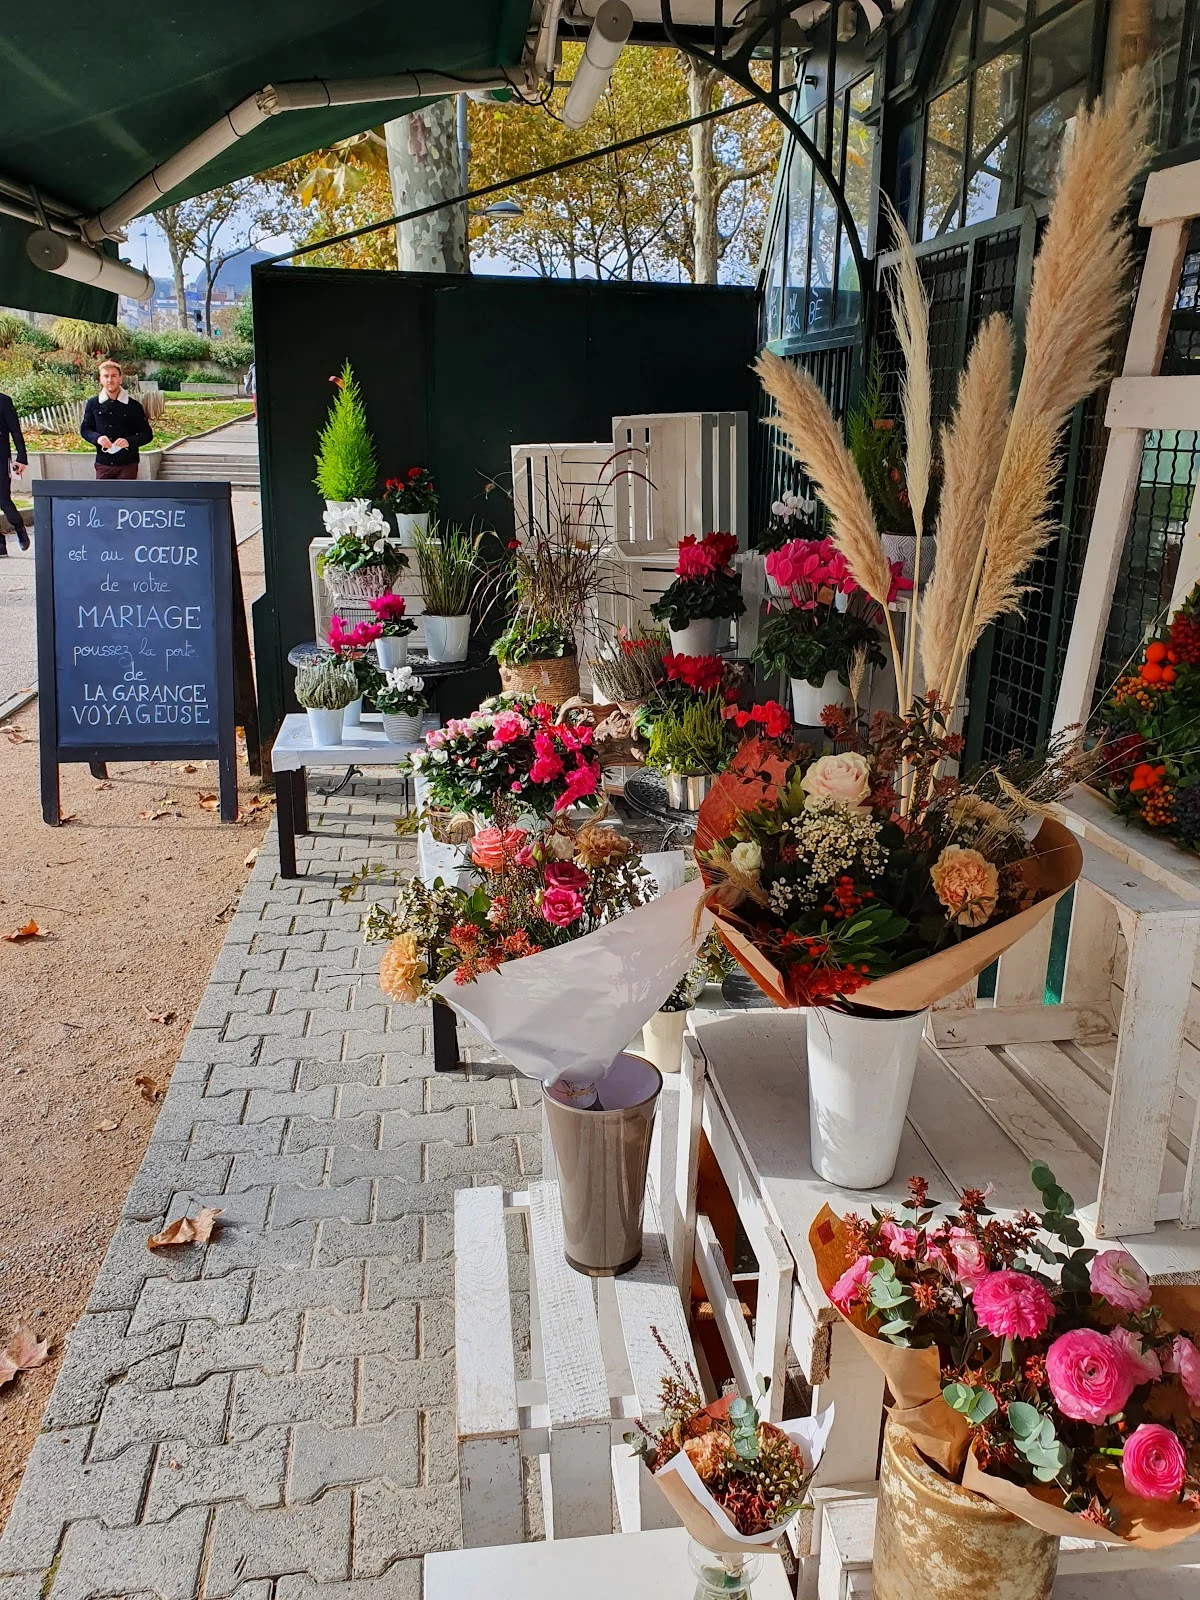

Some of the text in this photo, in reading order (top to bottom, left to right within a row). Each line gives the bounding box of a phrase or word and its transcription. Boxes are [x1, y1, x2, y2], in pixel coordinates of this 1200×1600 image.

[67, 506, 186, 530] si la POESIE
[68, 545, 88, 562] est
[100, 550, 124, 562] au
[100, 571, 171, 593] de votre
[77, 604, 202, 630] MARIAGE
[73, 637, 200, 672] poussez la porte
[123, 660, 147, 682] de
[84, 683, 207, 703] LA GARANCE
[71, 703, 210, 726] VOYAGEUSE
